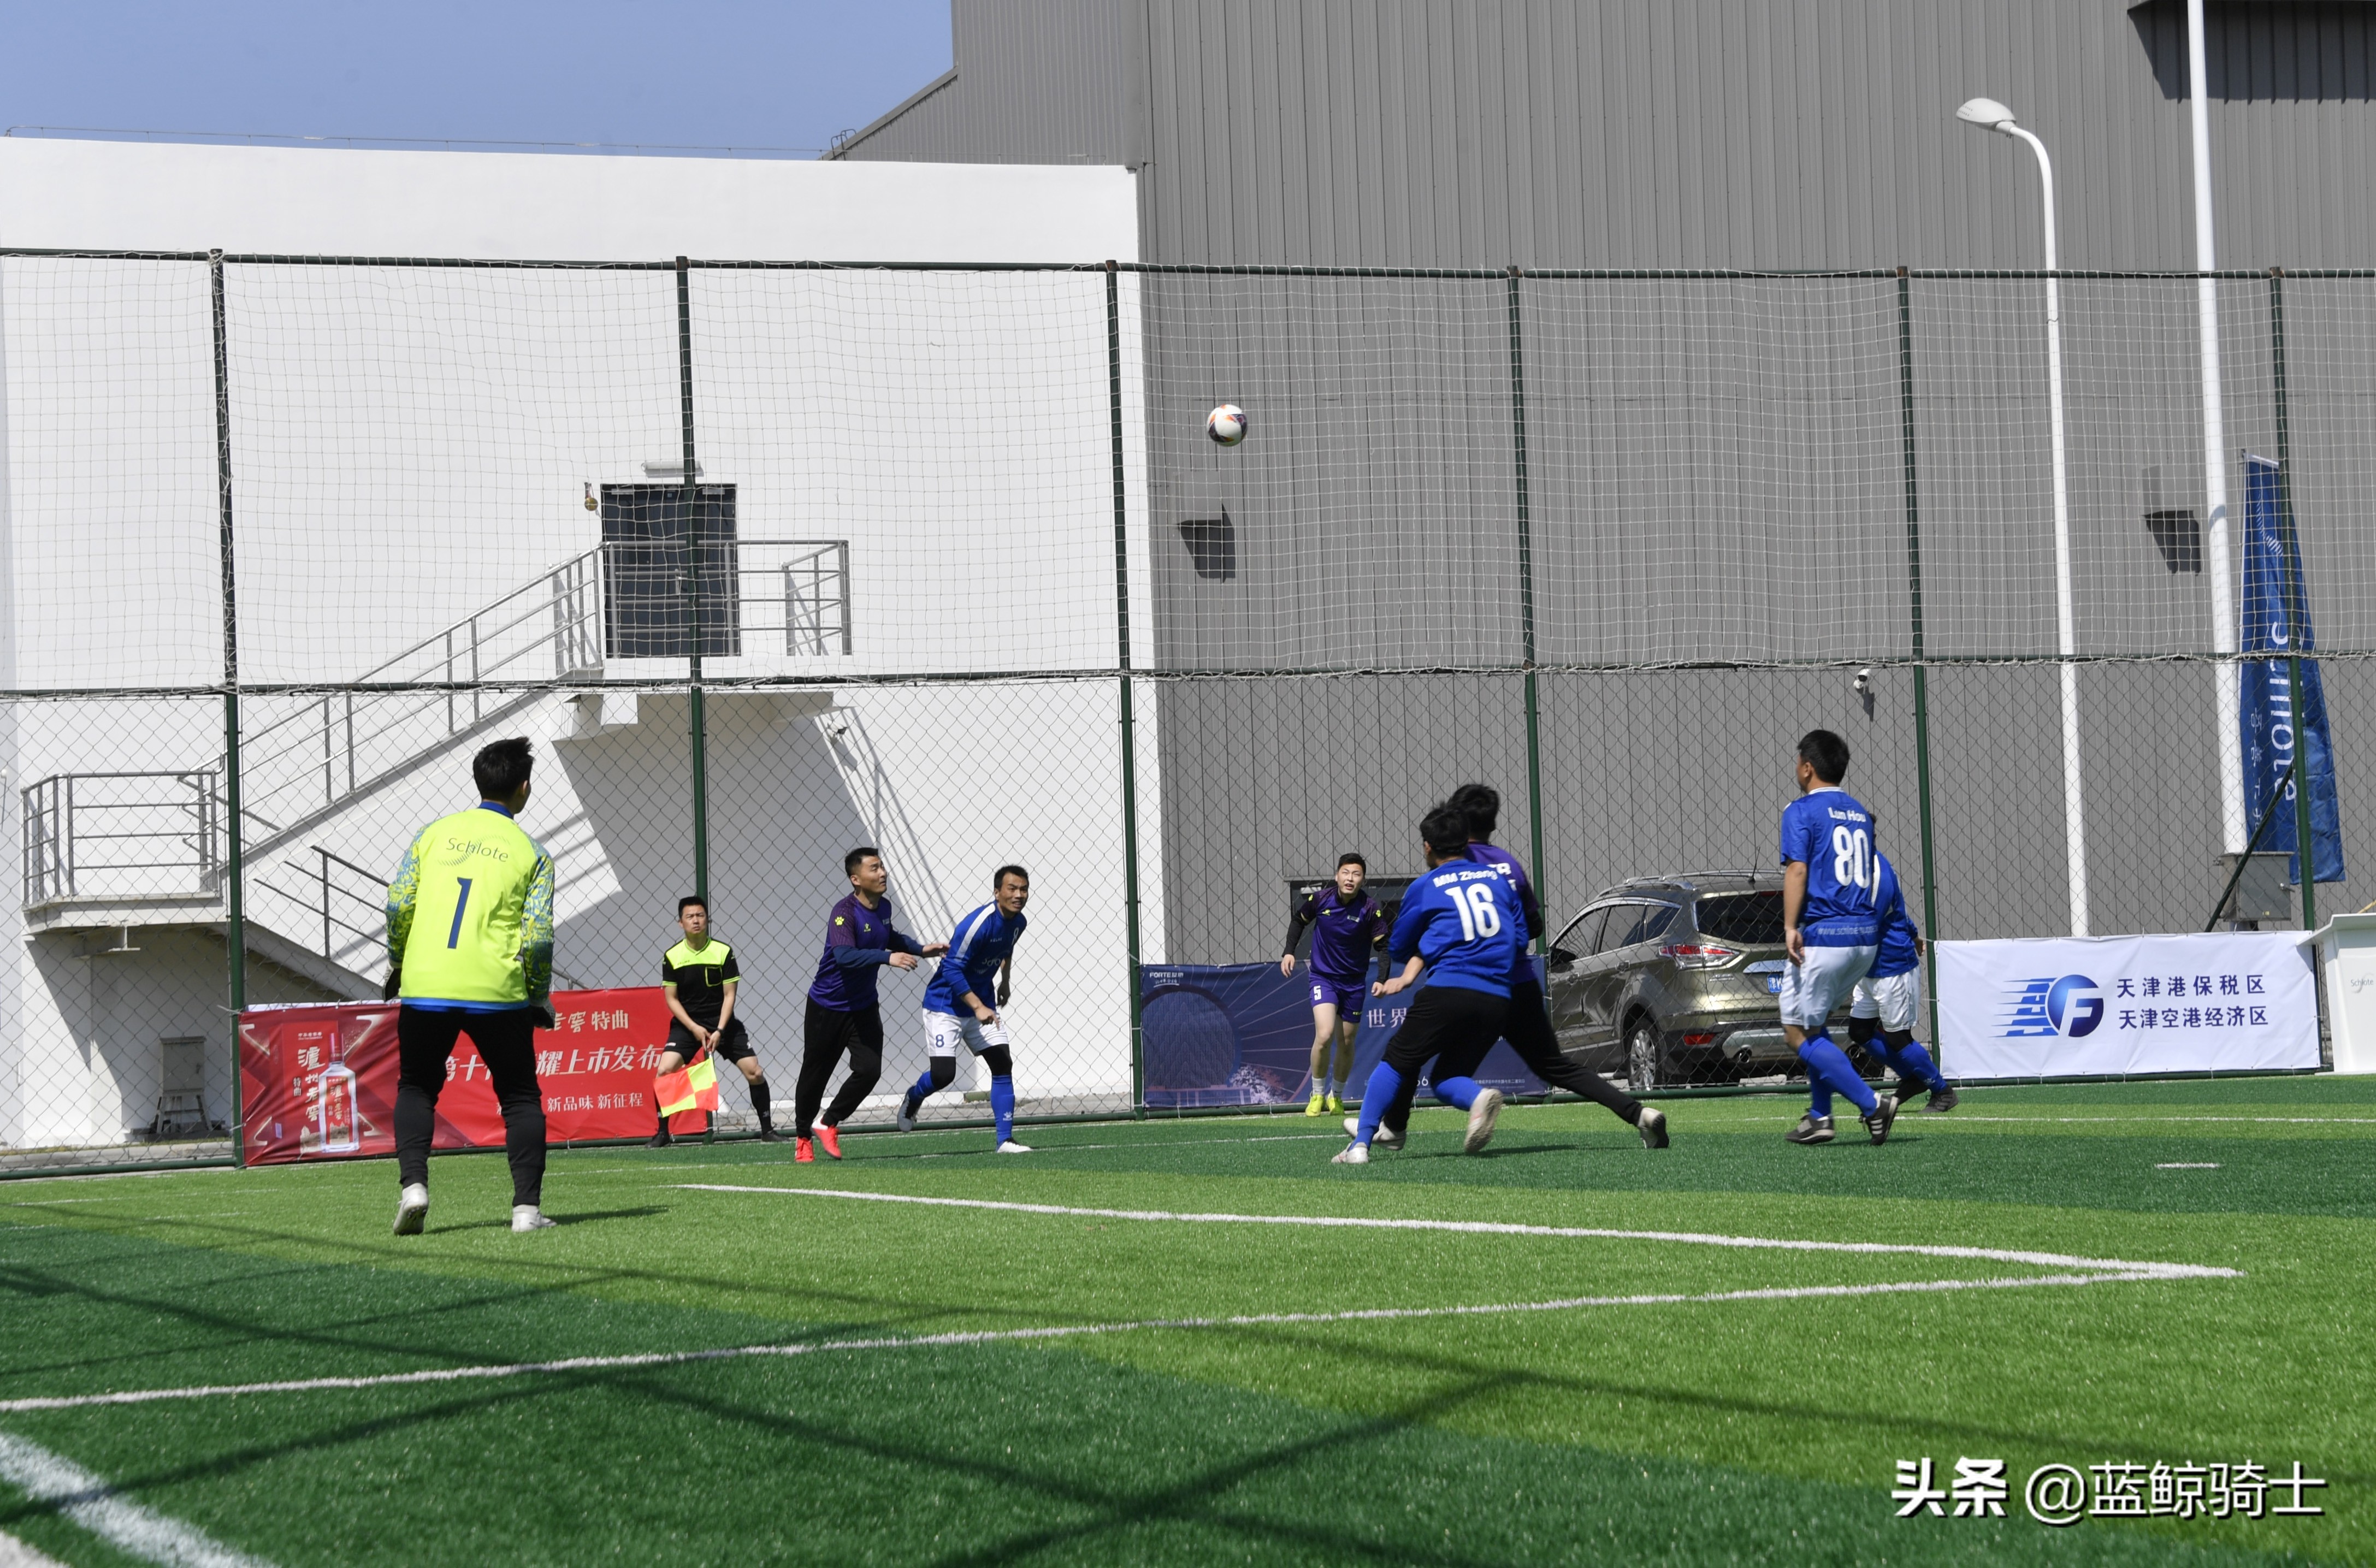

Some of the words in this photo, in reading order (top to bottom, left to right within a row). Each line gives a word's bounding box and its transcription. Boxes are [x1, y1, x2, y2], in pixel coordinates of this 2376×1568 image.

[446, 838, 509, 862] Schlote
[1833, 826, 1870, 889] 80
[447, 877, 473, 949] 1
[1445, 883, 1501, 941] 16
[1313, 985, 1322, 1001] 5
[2117, 974, 2265, 998] 天津港保税区
[2350, 978, 2374, 987] Schlote
[592, 1009, 629, 1031] 特曲
[1366, 1007, 1408, 1028] 世界
[2119, 1005, 2268, 1029] 天津空港经济区
[936, 1034, 944, 1048] 8
[293, 1077, 302, 1097] 特曲
[547, 1096, 594, 1113] 新品味
[598, 1092, 644, 1109] 新征程
